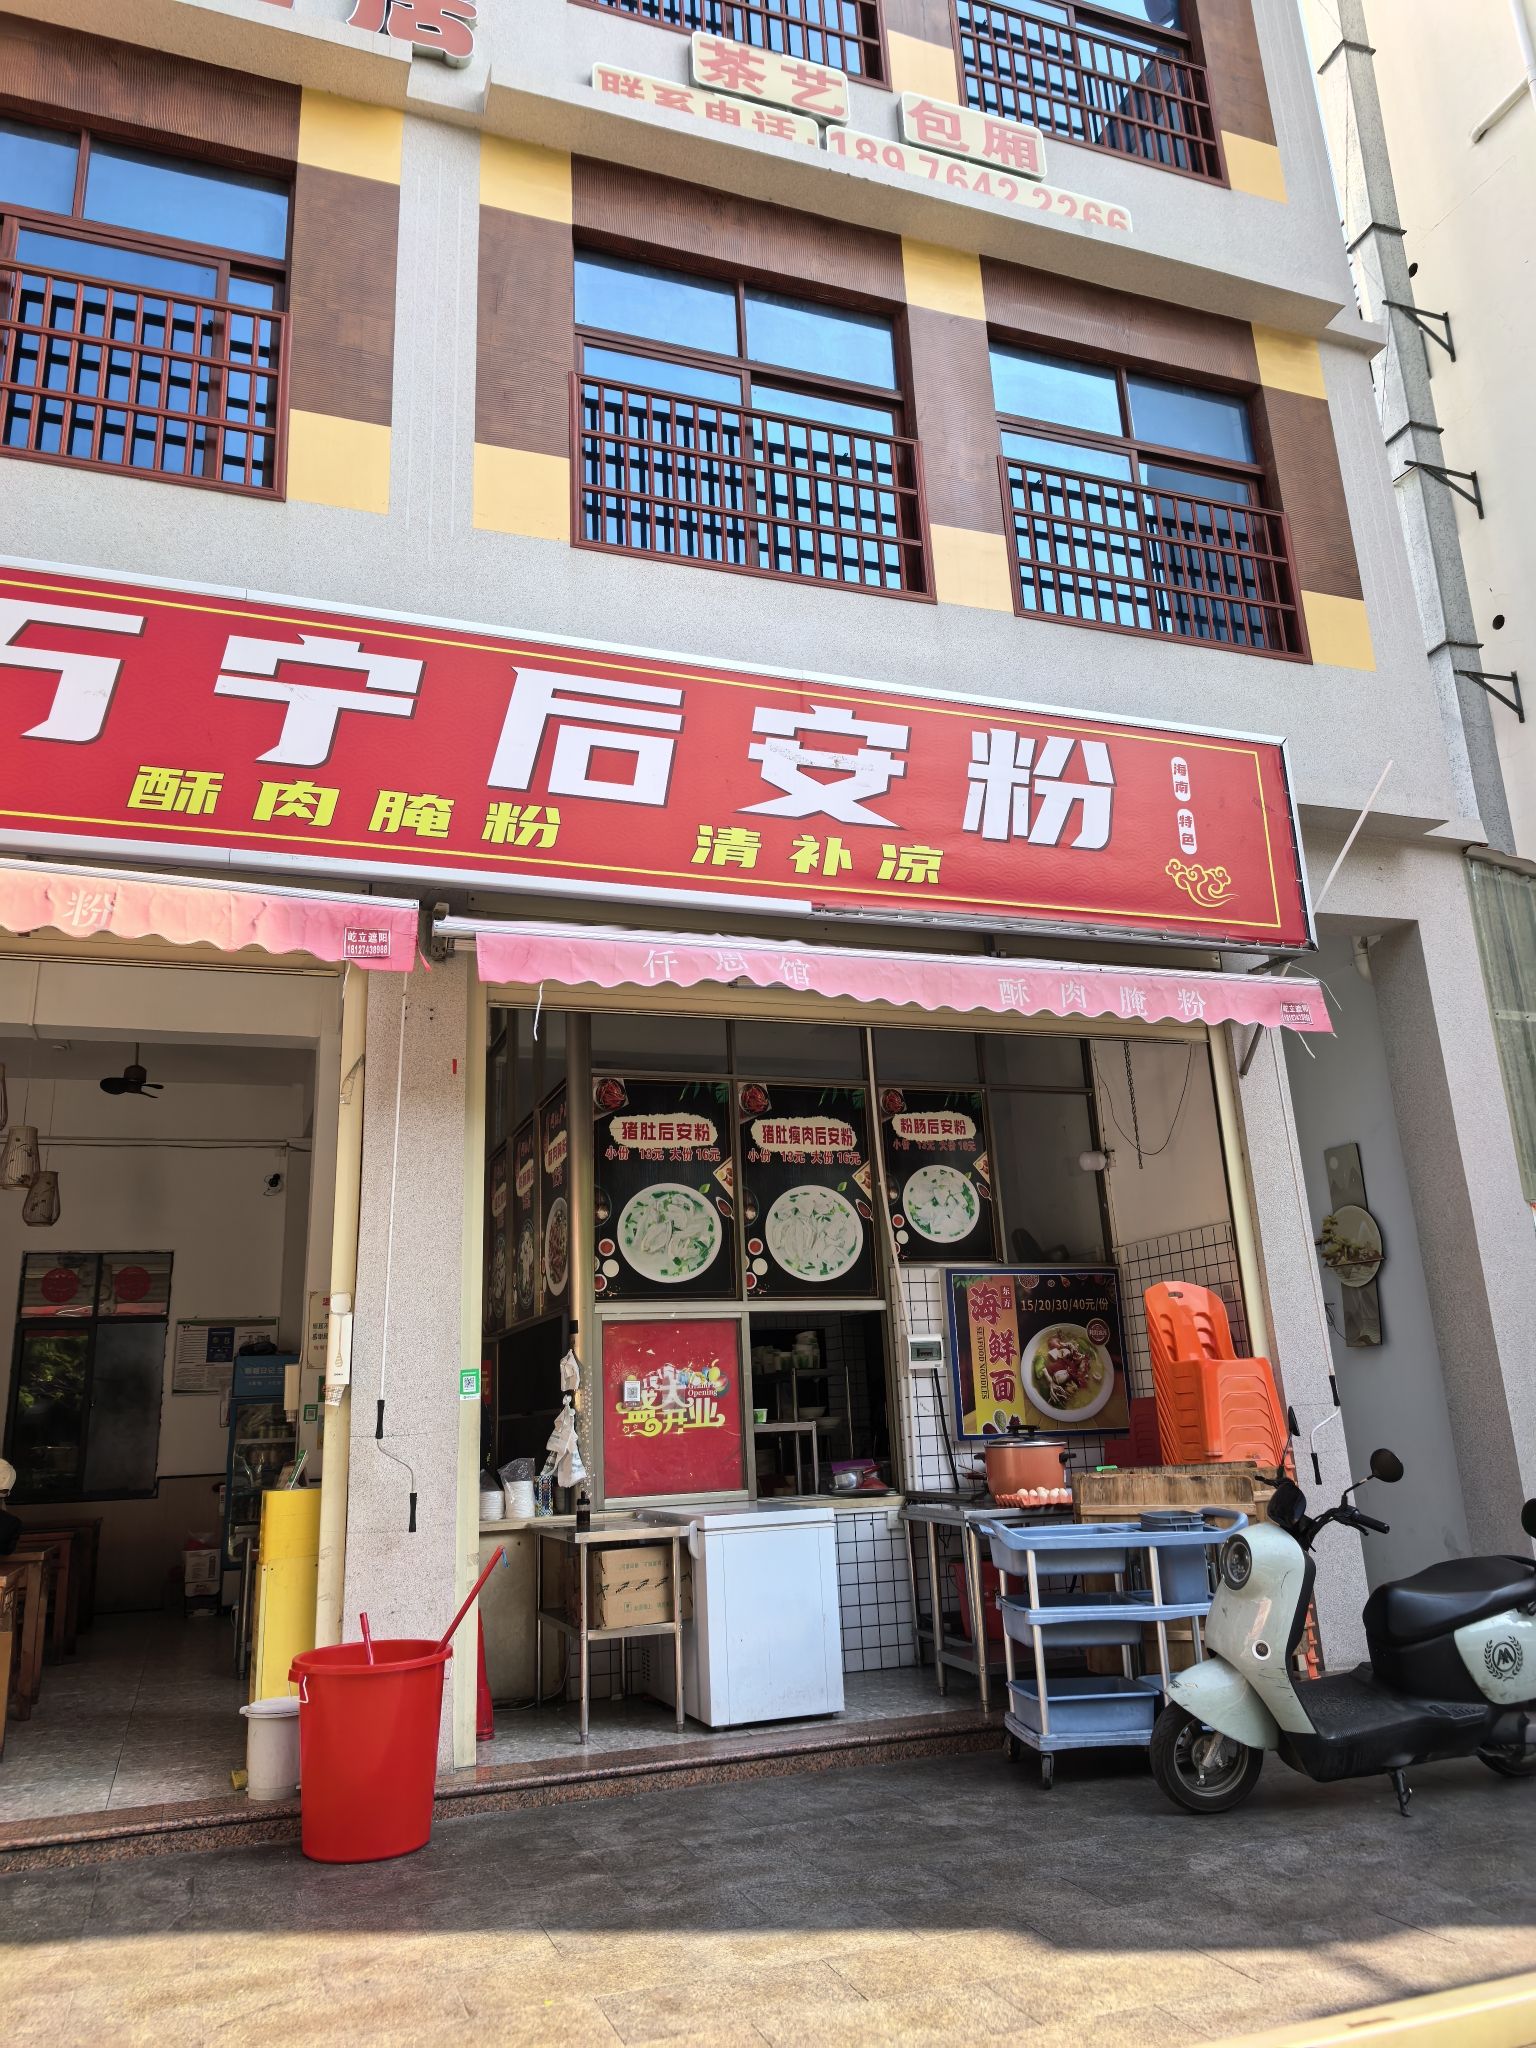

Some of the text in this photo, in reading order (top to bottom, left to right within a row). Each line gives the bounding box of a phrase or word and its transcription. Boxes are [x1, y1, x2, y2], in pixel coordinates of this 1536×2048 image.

[698, 40, 846, 117] 茶艺
[907, 99, 1039, 172] 包厢
[126, 765, 562, 849] 酥肉腌粉
[1173, 763, 1195, 846] 海南 特色
[690, 824, 945, 885] 清补凉
[998, 978, 1207, 1018] 酥肉腌粉
[621, 1121, 710, 1142] 猪肚后安粉
[761, 1124, 853, 1147] 猪肚瘦肉后安粉
[900, 1118, 967, 1136] 粉肠后安粉
[969, 1282, 1018, 1404] 海鲜面
[976, 1326, 989, 1400] SEAFOOD NOODLES
[687, 1388, 718, 1397] Opening
